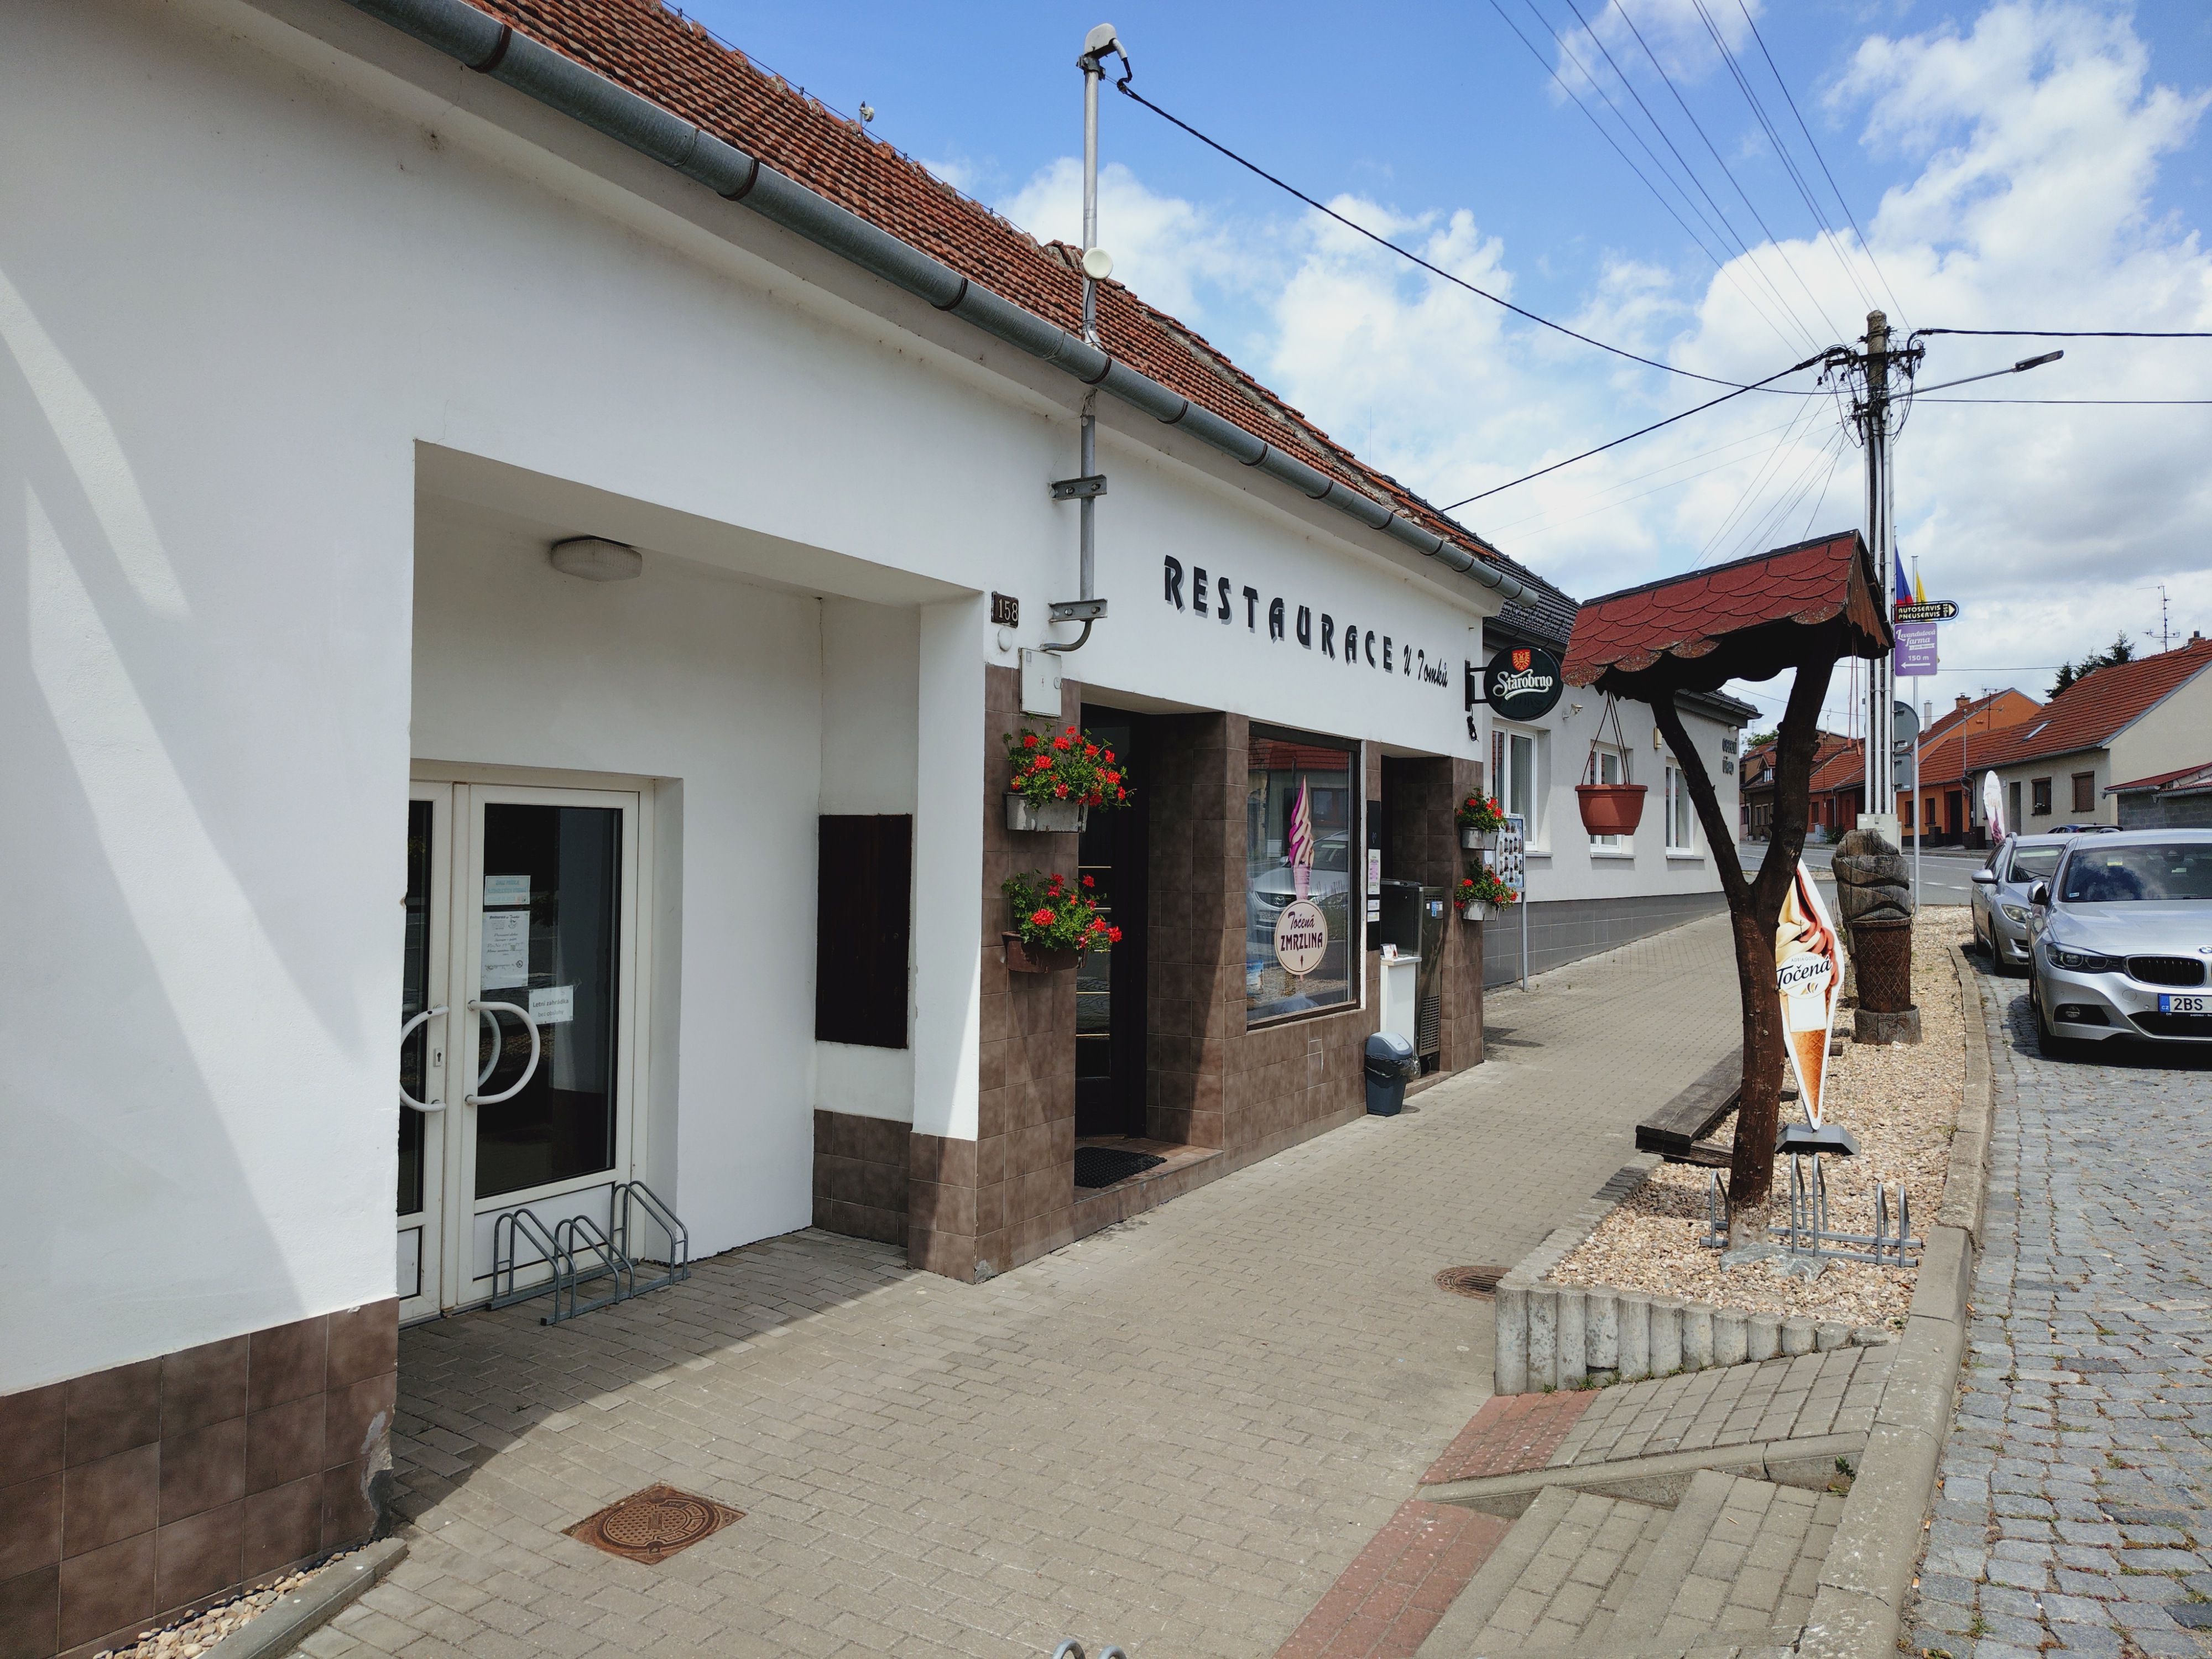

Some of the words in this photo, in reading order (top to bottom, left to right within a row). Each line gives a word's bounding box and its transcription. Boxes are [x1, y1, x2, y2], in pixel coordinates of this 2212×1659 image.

[998, 598, 1018, 622] 158
[1898, 604, 1941, 613] AUTOSERVIS
[1898, 611, 1940, 620] PNEUSERVIS
[1164, 555, 1392, 671] RESTAURACE
[1404, 644, 1412, 676] U
[1417, 649, 1448, 688] Tomků
[1896, 629, 1936, 641] Levandulová
[1905, 638, 1931, 647] farma
[1493, 669, 1553, 701] Starobrno
[1287, 911, 1315, 930] Točená
[1280, 932, 1323, 952] ZMRZLINA
[1777, 956, 1833, 990] Točená
[2174, 998, 2203, 1011] 2BS
